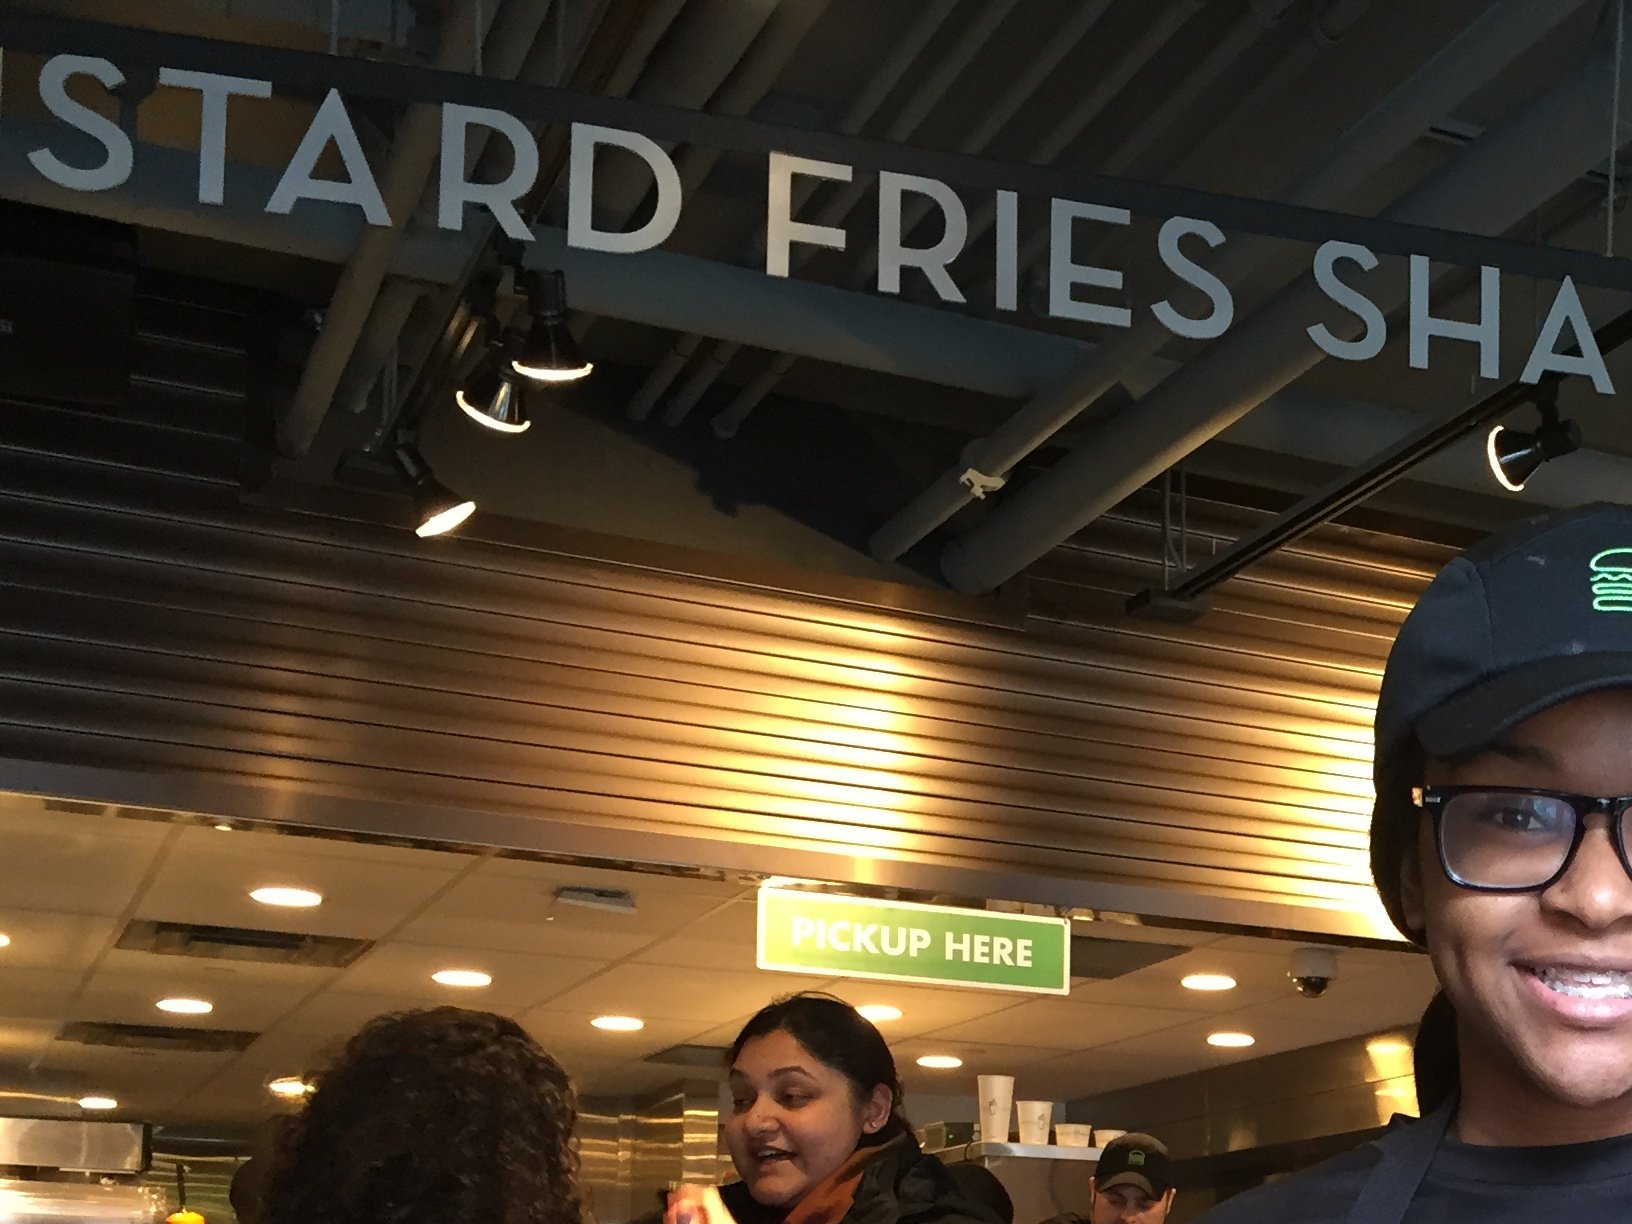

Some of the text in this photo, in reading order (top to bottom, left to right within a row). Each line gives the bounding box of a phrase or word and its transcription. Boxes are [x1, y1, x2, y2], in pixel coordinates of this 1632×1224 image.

[766, 151, 1234, 340] FRIES
[791, 917, 1033, 968] PICKUP HERE
